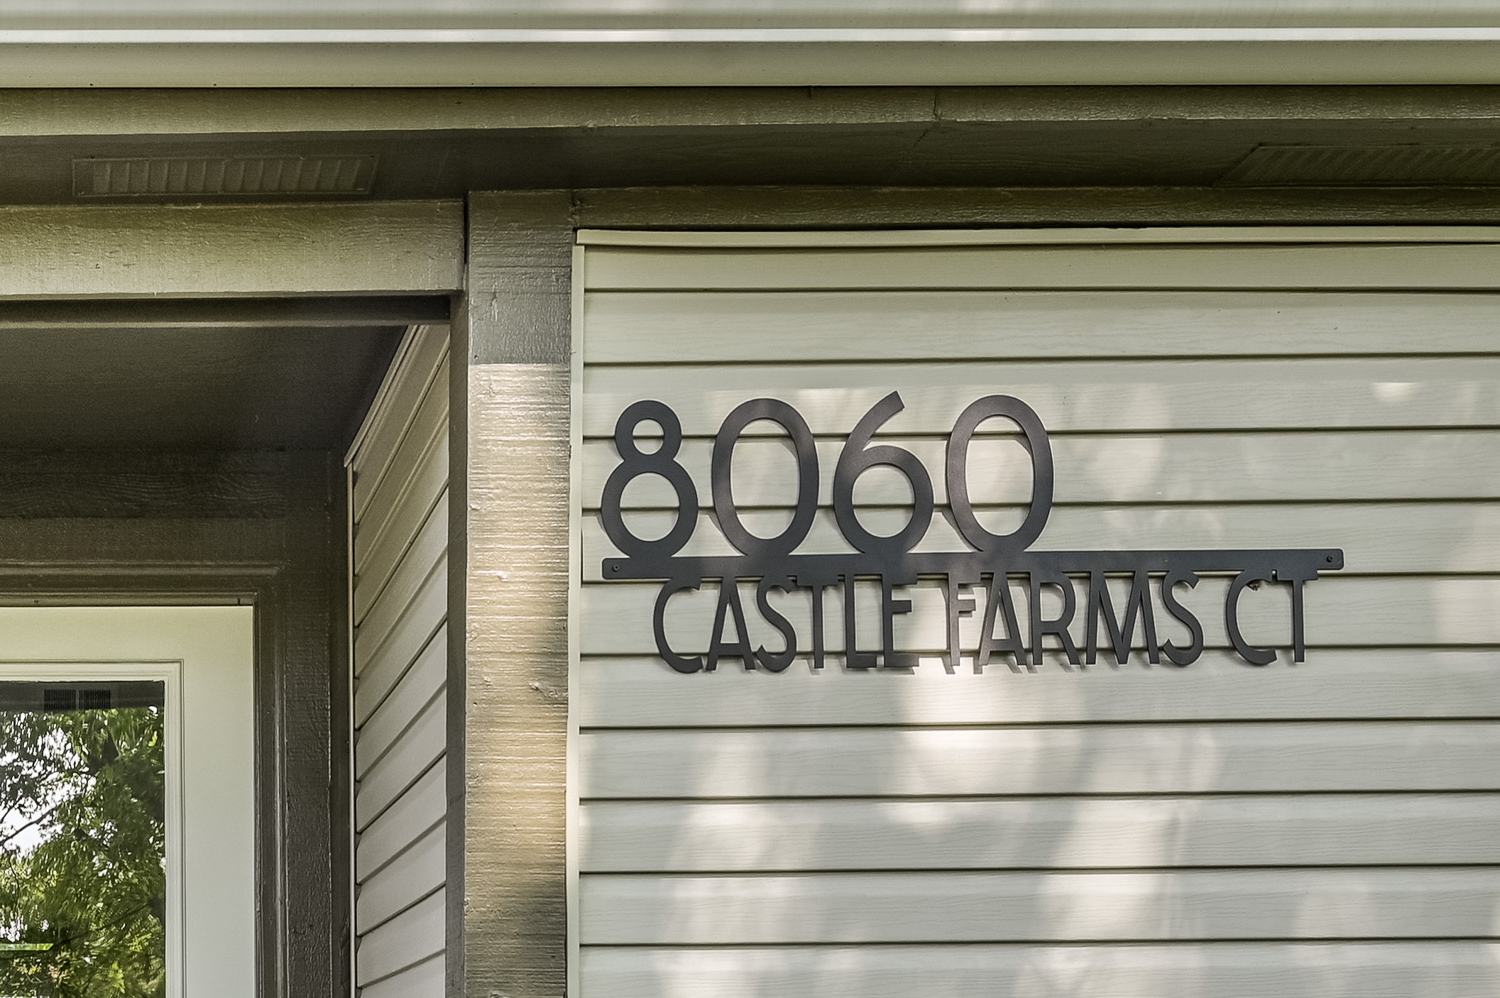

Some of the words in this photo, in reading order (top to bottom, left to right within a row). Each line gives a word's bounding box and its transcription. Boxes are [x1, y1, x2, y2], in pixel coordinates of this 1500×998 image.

[600, 390, 1054, 556] 8060
[653, 571, 919, 674] CASTLE
[946, 570, 1204, 667] FARMS
[1225, 569, 1318, 665] CT
